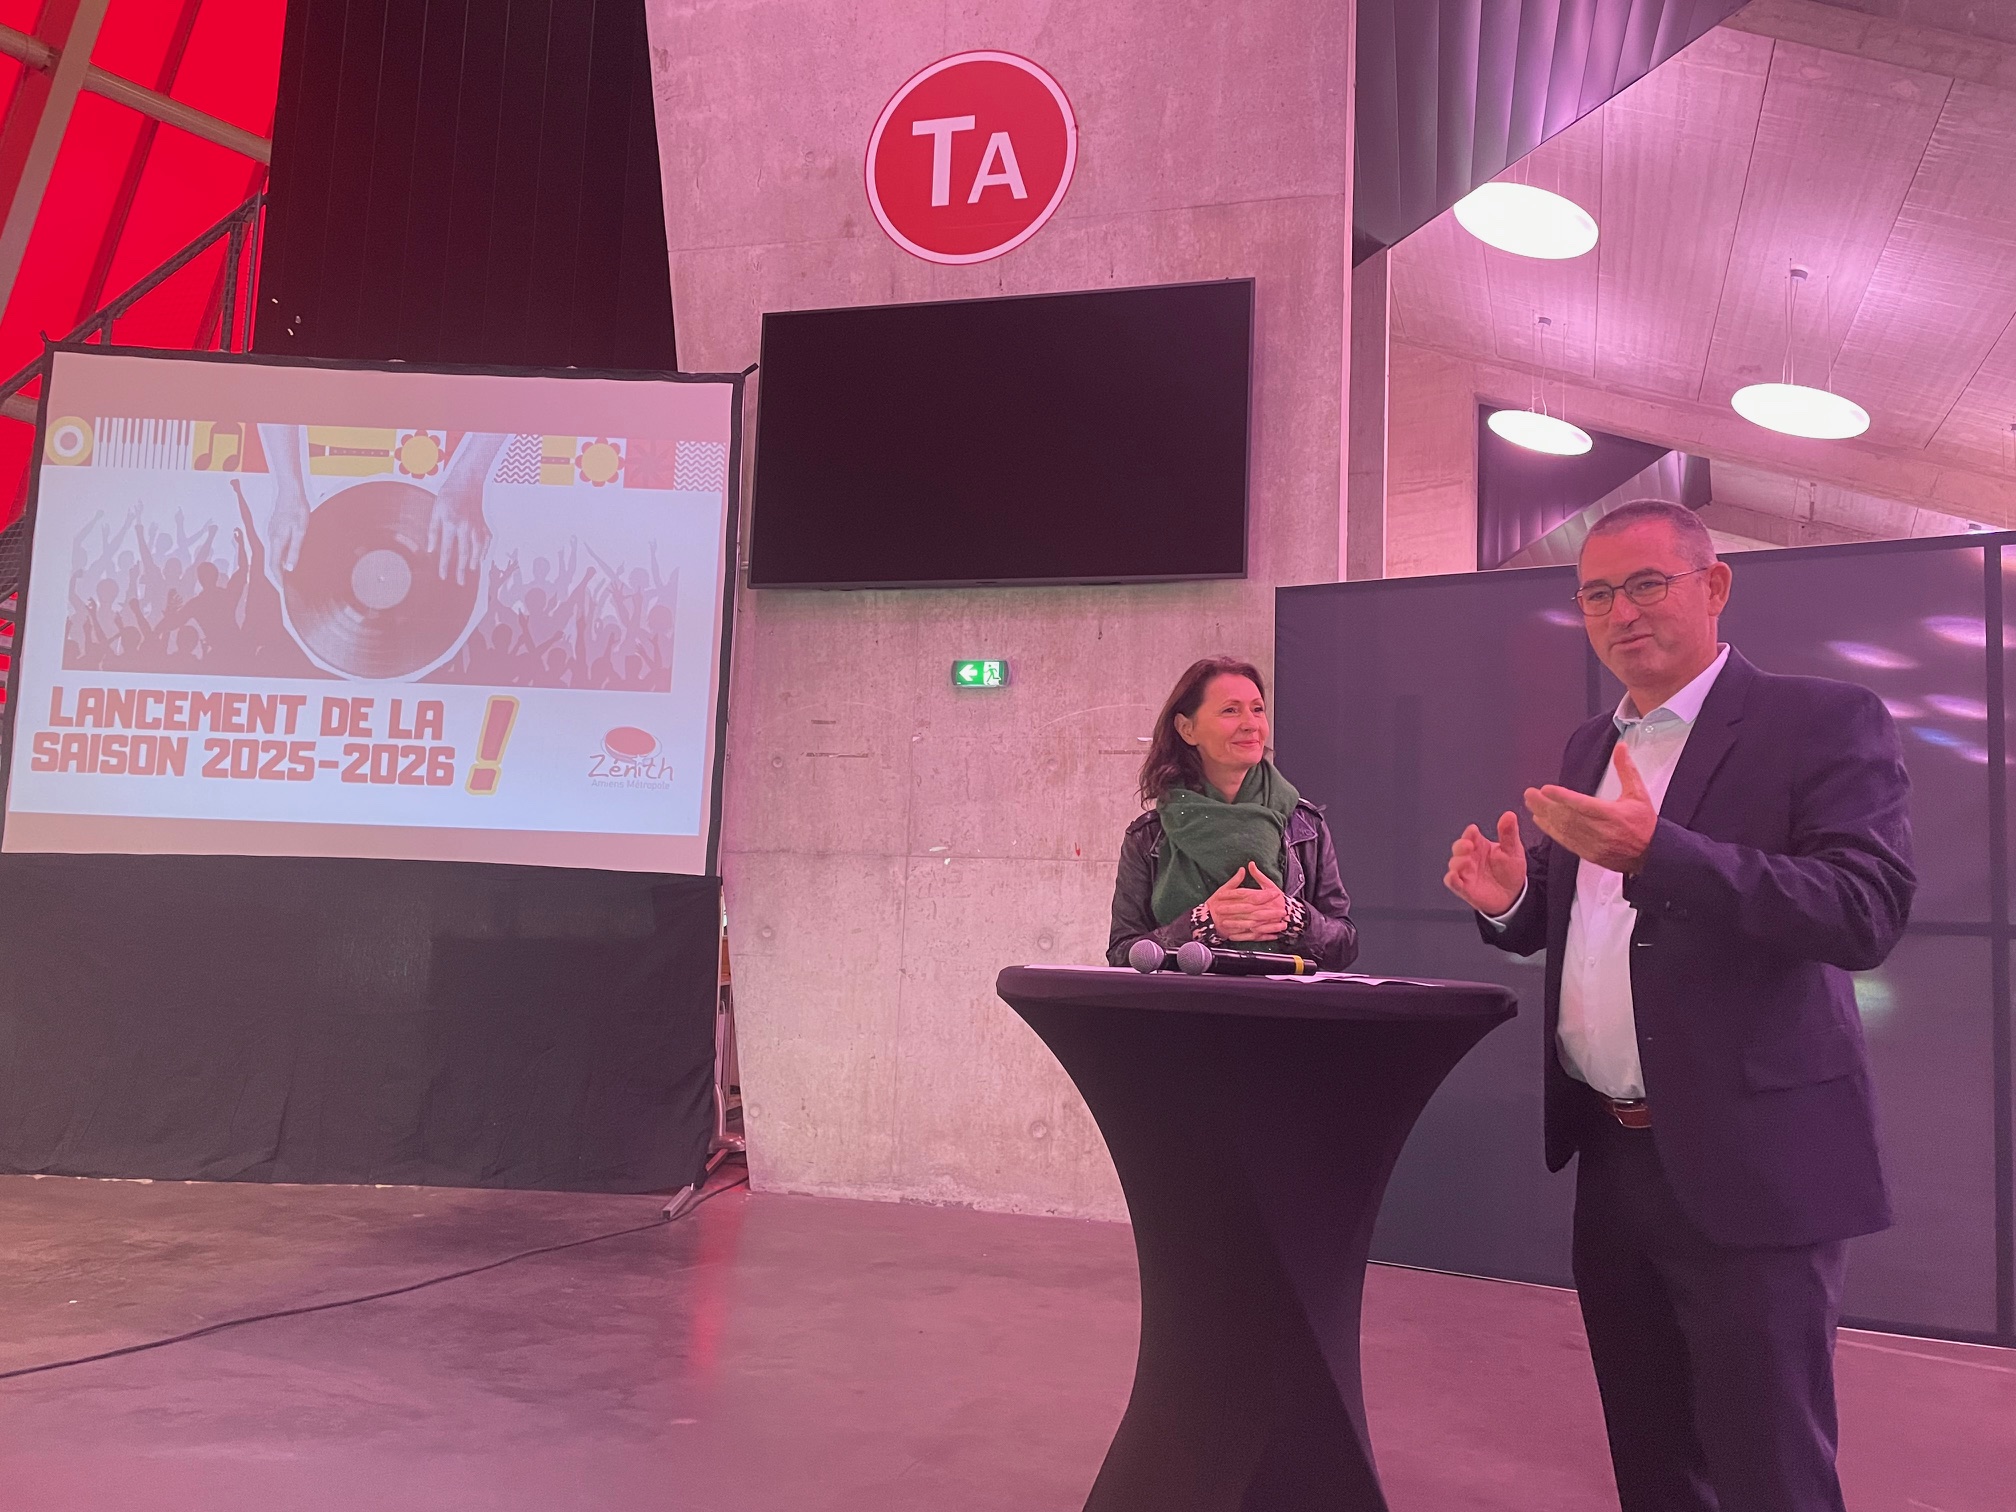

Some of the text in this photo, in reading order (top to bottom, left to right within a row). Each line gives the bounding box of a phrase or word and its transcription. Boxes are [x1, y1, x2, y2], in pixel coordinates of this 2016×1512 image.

[911, 114, 1029, 207] TA
[49, 685, 445, 741] LANCEMENT DE LA
[30, 731, 190, 777] SAISON
[201, 737, 456, 787] 2025-2026
[591, 778, 671, 791] Amiens Métropole
